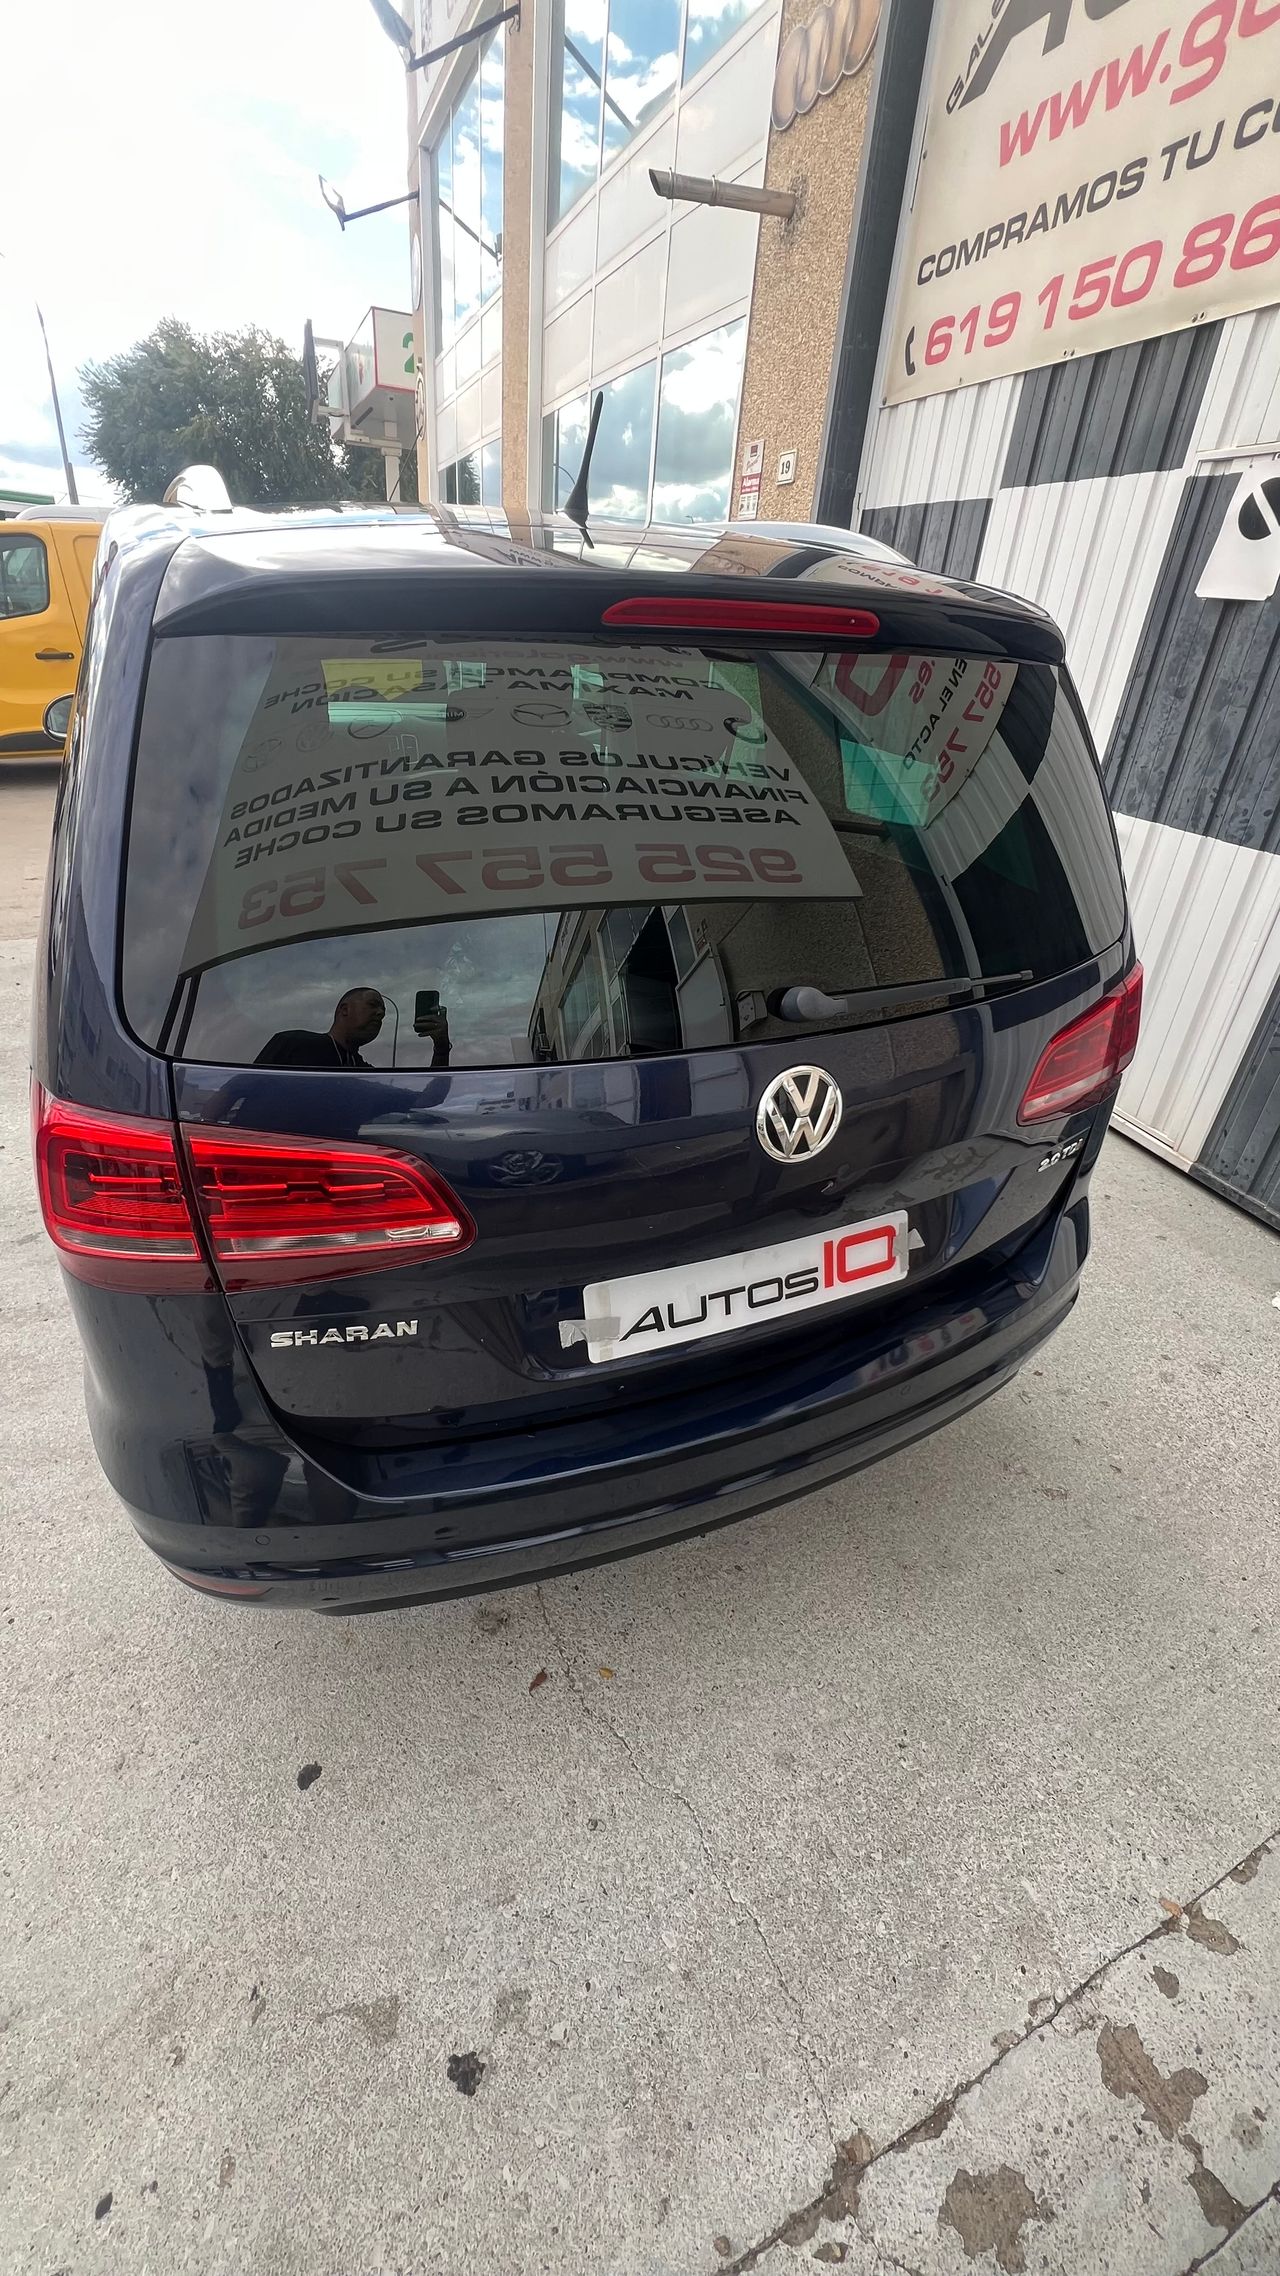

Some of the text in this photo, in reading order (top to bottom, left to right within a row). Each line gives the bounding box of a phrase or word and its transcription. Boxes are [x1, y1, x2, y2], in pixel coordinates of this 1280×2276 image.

[917, 98, 1280, 286] COMPRAMOS TU C
[924, 291, 1021, 366] 619
[1038, 239, 1163, 330] 150
[781, 460, 791, 475] 19
[270, 1319, 419, 1348] SHARAN
